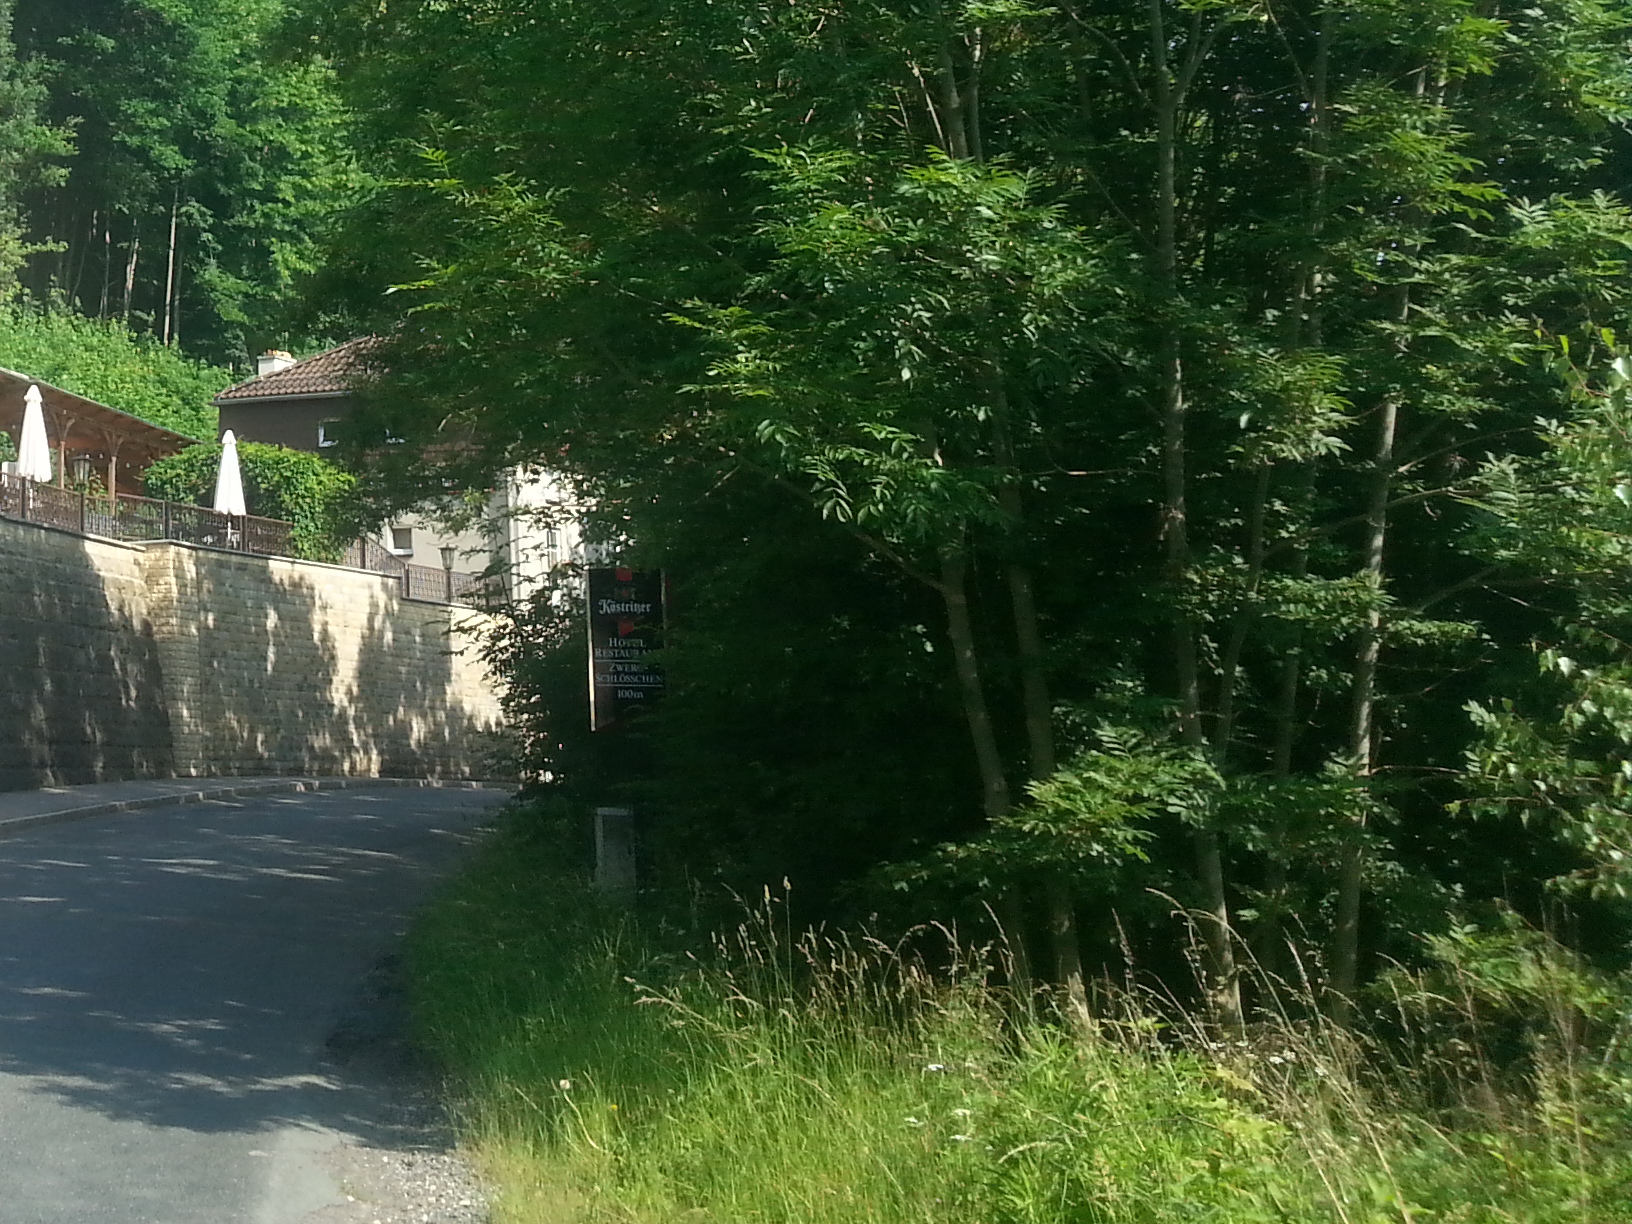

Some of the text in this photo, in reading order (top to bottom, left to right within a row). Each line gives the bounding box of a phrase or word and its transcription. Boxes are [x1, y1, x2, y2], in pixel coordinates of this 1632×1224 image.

[598, 599, 651, 614] Köstritzer
[609, 663, 649, 673] ZWER-
[617, 689, 644, 699] 100m
